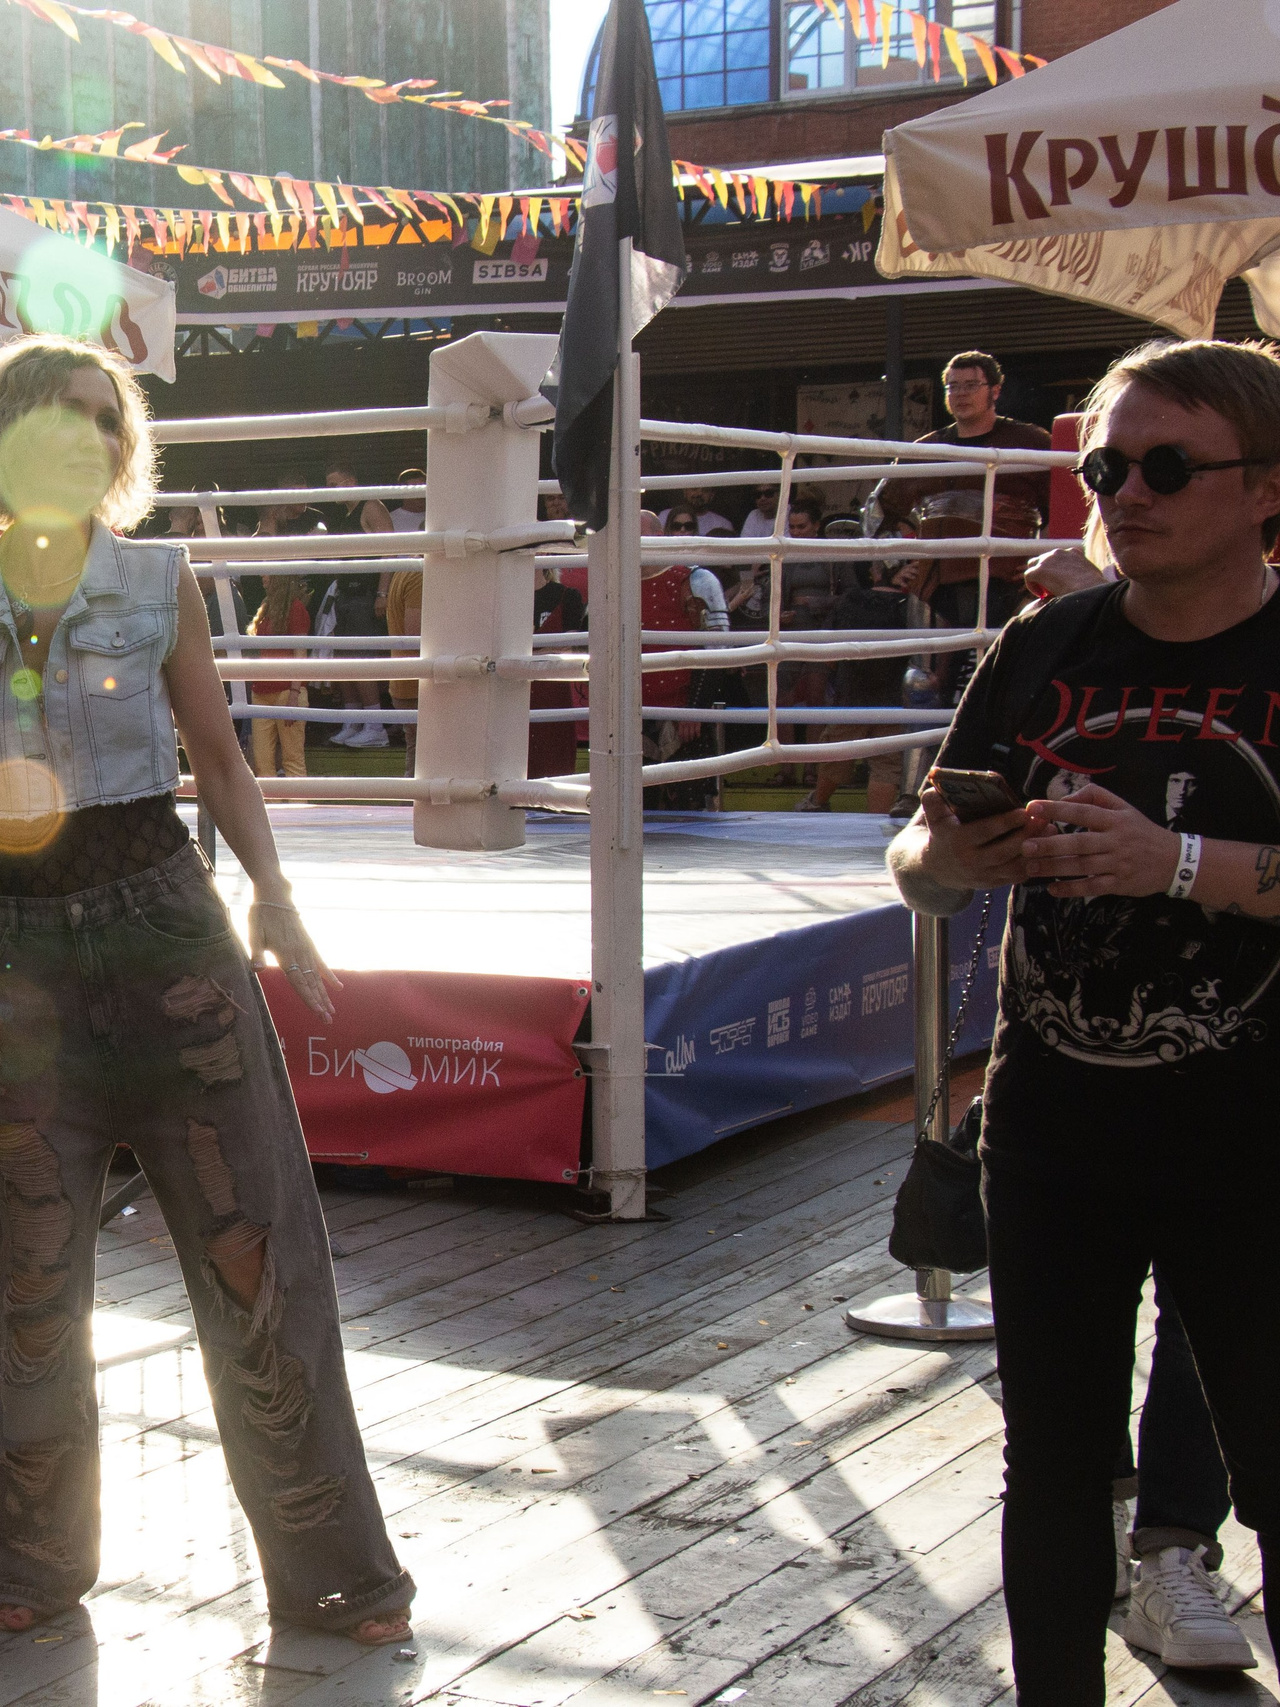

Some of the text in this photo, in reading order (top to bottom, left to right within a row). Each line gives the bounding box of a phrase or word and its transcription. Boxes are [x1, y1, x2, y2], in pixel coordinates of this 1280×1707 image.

[228, 267, 278, 283] БИТВА
[397, 270, 453, 287] BROOM
[478, 263, 543, 279] SIBSA
[297, 269, 378, 293] КРУТОЯР
[414, 287, 432, 296] GIN
[407, 1036, 504, 1055] типография
